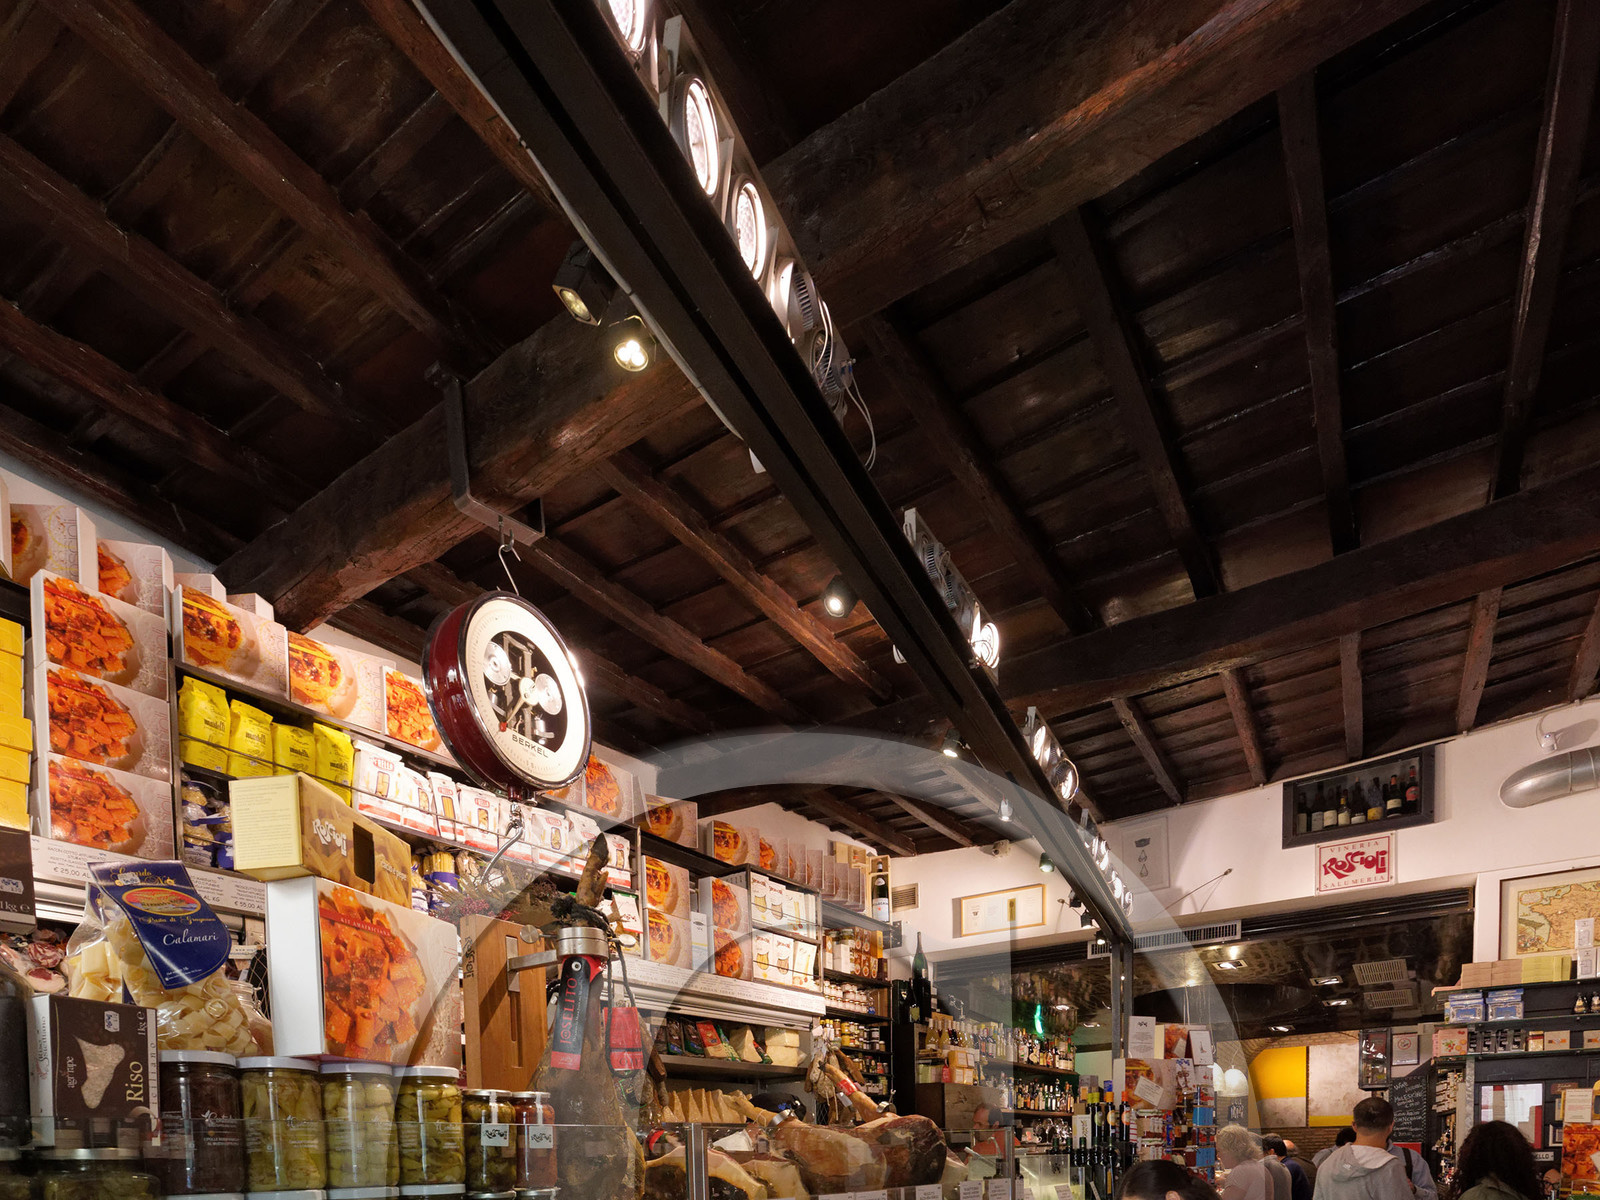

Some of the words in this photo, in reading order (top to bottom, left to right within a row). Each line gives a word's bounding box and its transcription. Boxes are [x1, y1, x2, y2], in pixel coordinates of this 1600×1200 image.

[512, 734, 549, 758] BERKEL
[1330, 841, 1379, 853] VINERIA
[1323, 875, 1385, 888] SALUMERIA
[163, 929, 219, 946] Calamari
